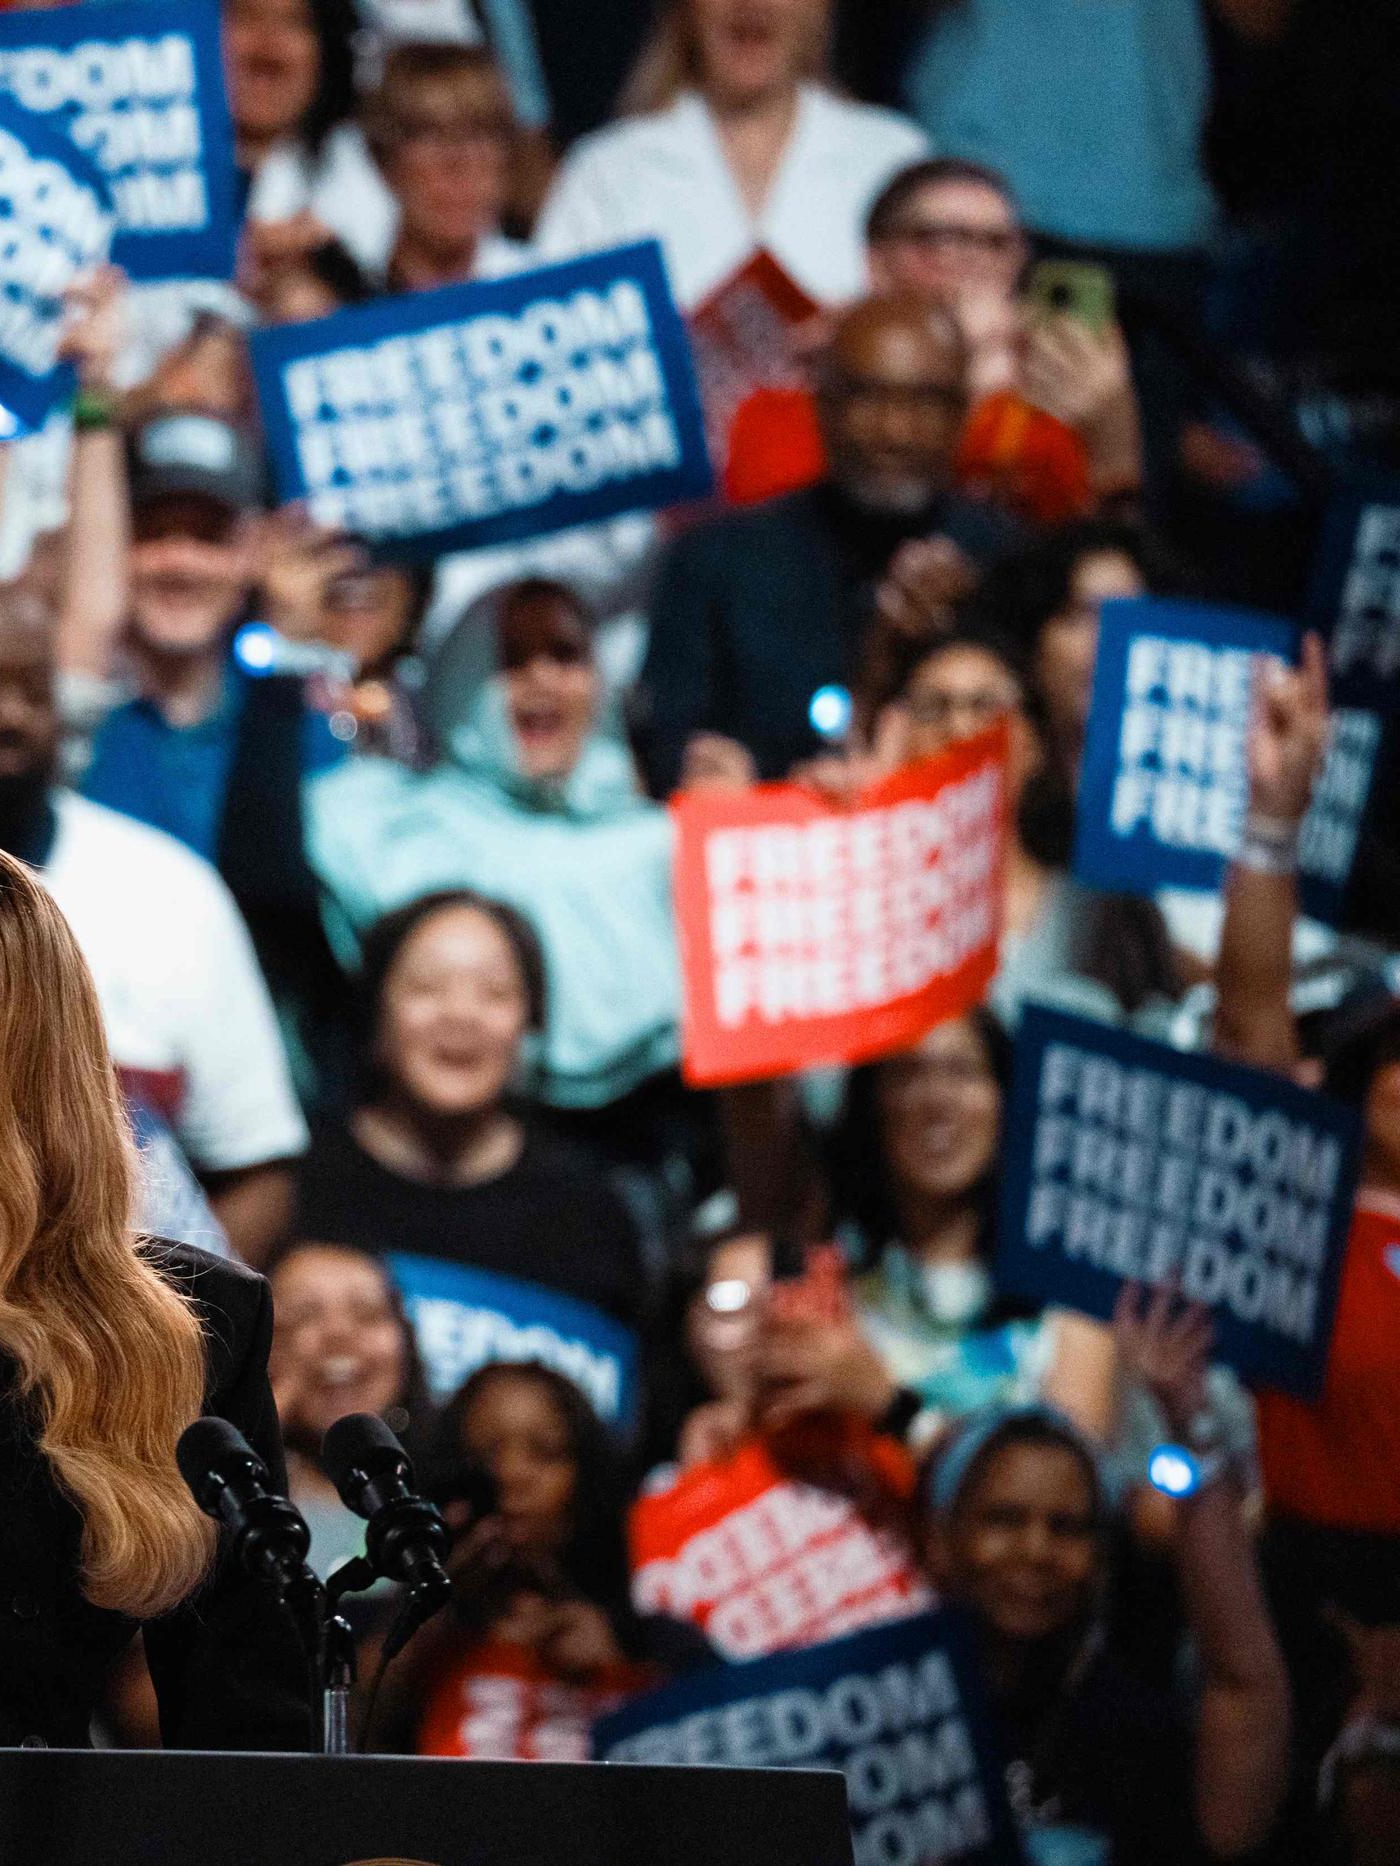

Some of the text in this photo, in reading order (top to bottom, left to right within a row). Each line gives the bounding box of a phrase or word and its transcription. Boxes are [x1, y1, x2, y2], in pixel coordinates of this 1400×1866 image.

[282, 280, 650, 420] FREEDOM
[298, 346, 666, 485] FREEDOM
[1032, 1110, 1330, 1272] FREEDOM
[1038, 1040, 1342, 1200] FREEDOM
[1024, 1183, 1316, 1345] FREEDOM
